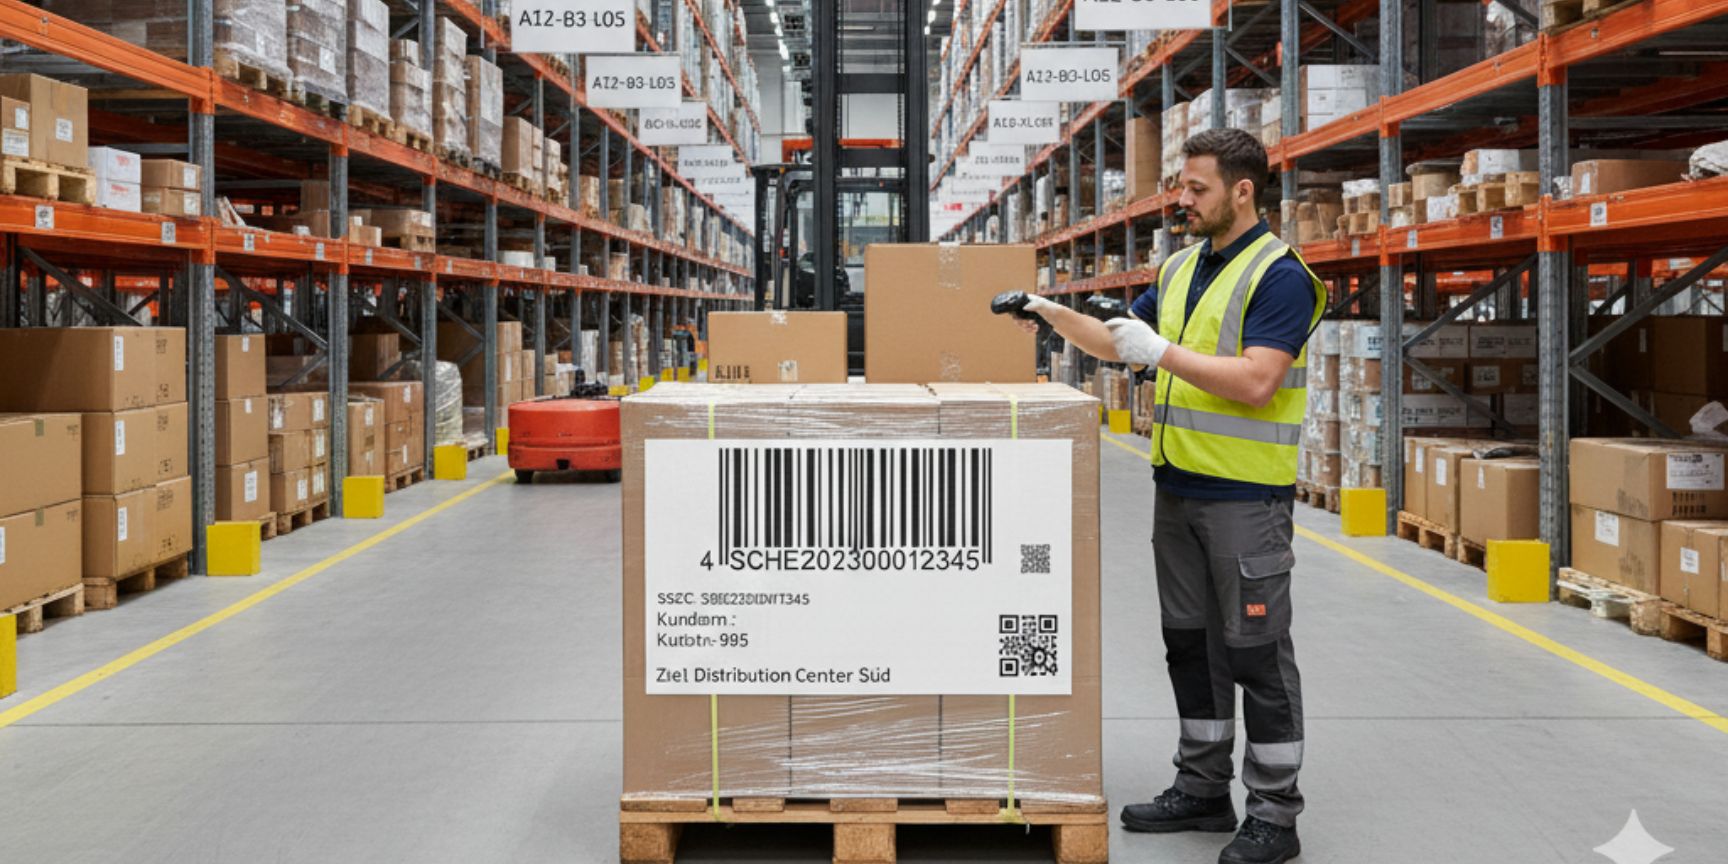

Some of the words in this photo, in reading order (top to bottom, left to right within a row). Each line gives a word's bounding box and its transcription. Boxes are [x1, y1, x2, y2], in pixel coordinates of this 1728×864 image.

[699, 550, 714, 571] 4
[729, 550, 980, 572] SCHE202300012345
[694, 666, 792, 683] Distribution
[795, 667, 854, 683] Center
